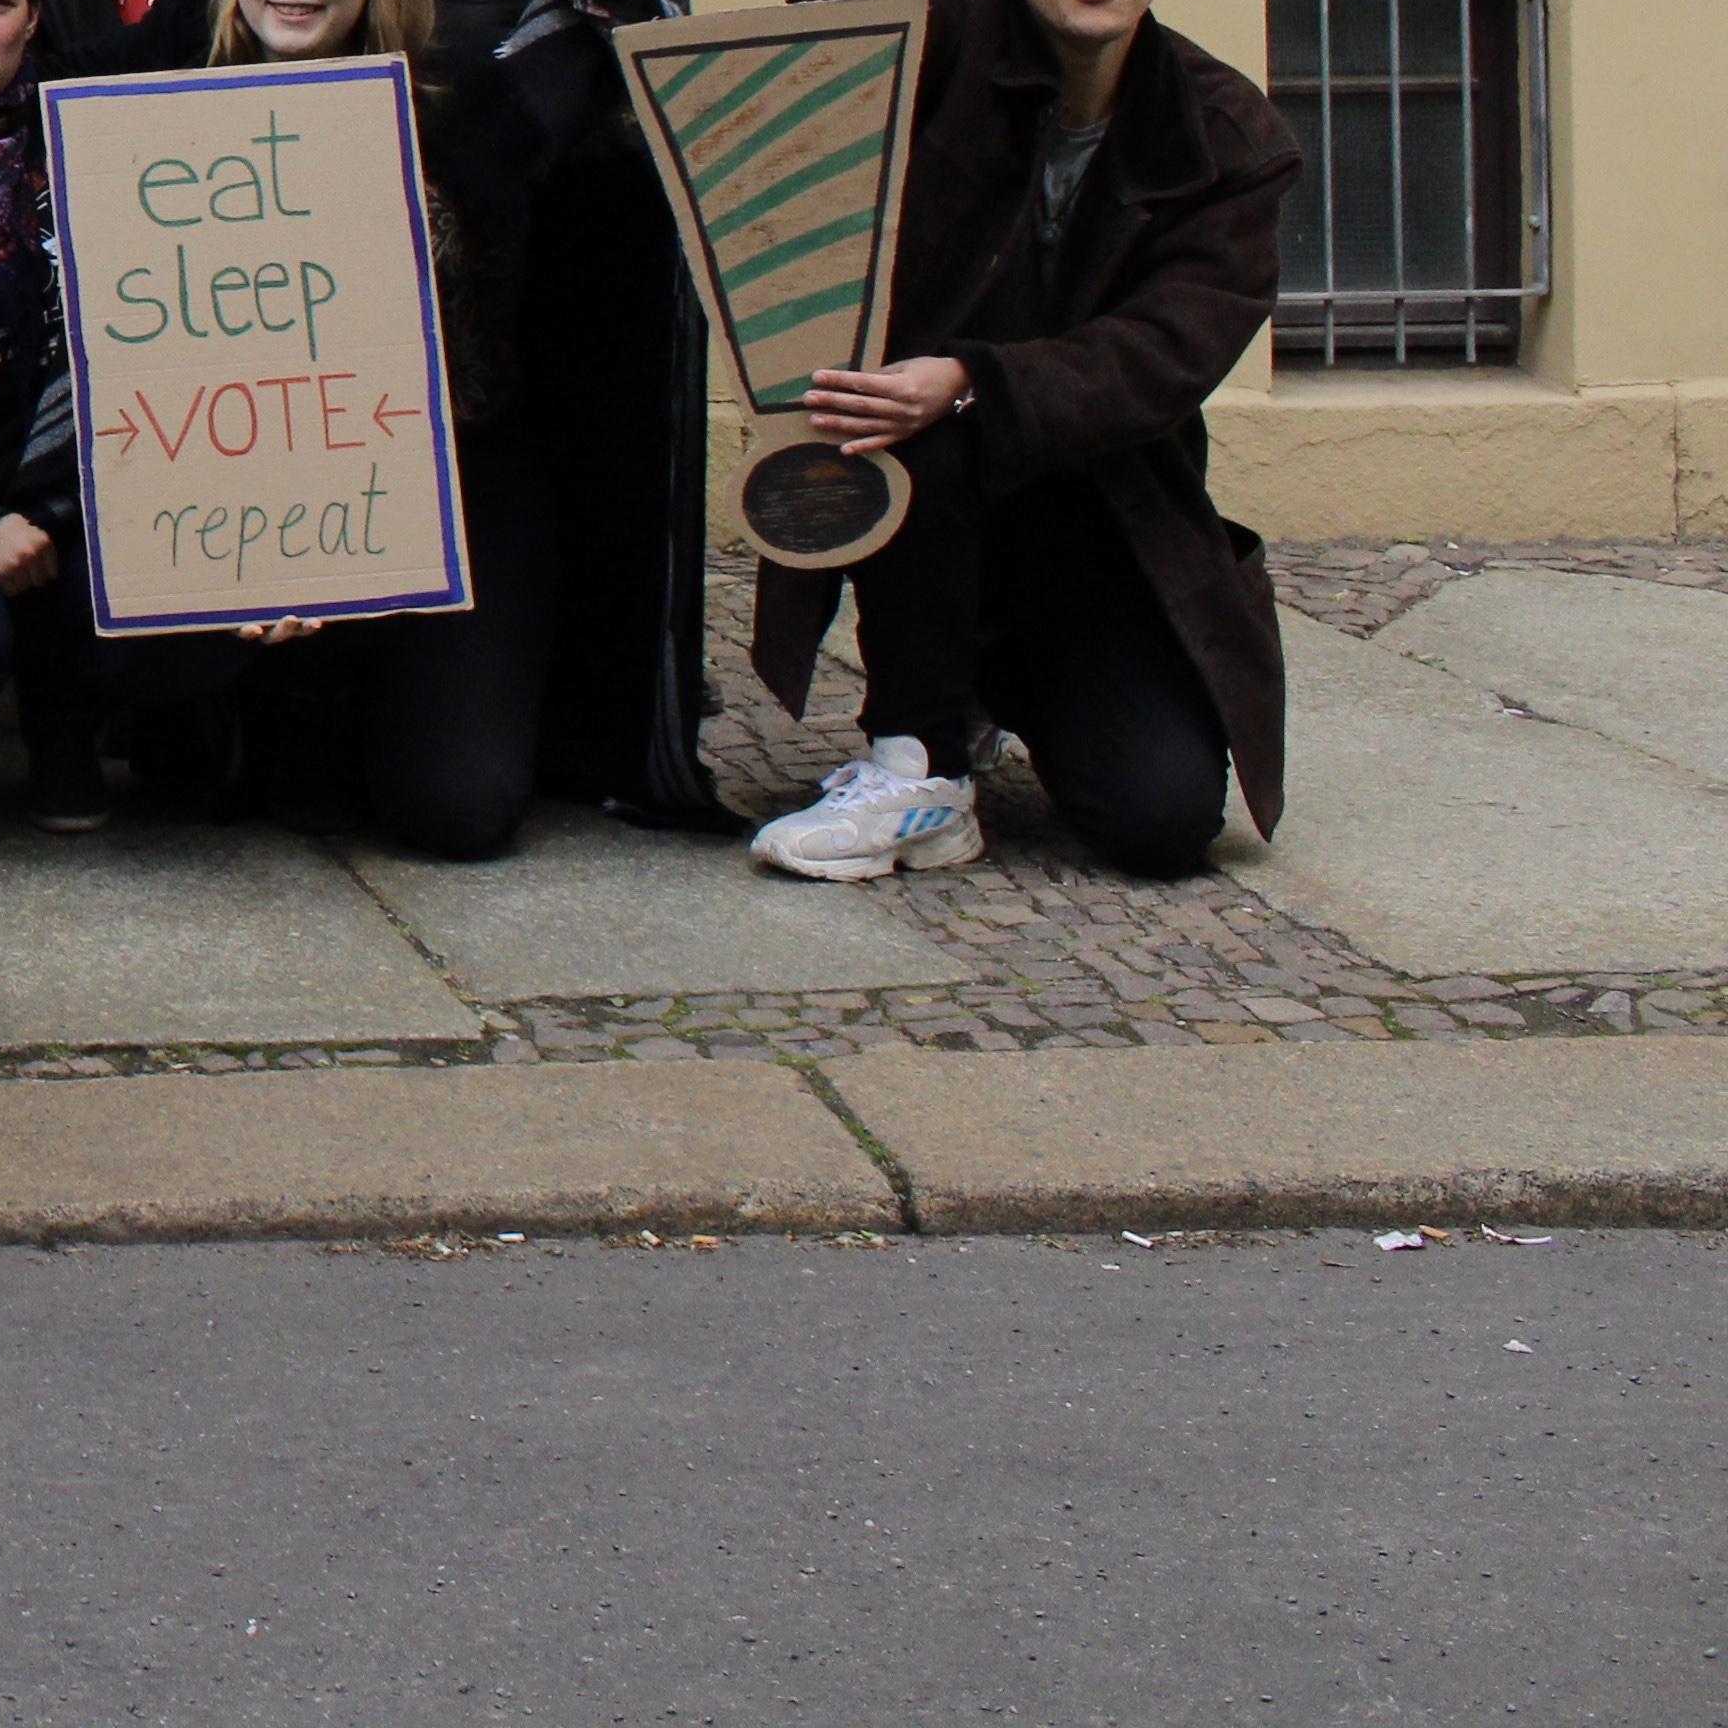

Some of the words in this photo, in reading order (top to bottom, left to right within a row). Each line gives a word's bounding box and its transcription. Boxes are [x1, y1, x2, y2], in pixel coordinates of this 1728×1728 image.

[137, 109, 312, 227] eat
[104, 244, 338, 362] sleep
[136, 373, 368, 462] VOTE
[153, 462, 389, 582] repeat
